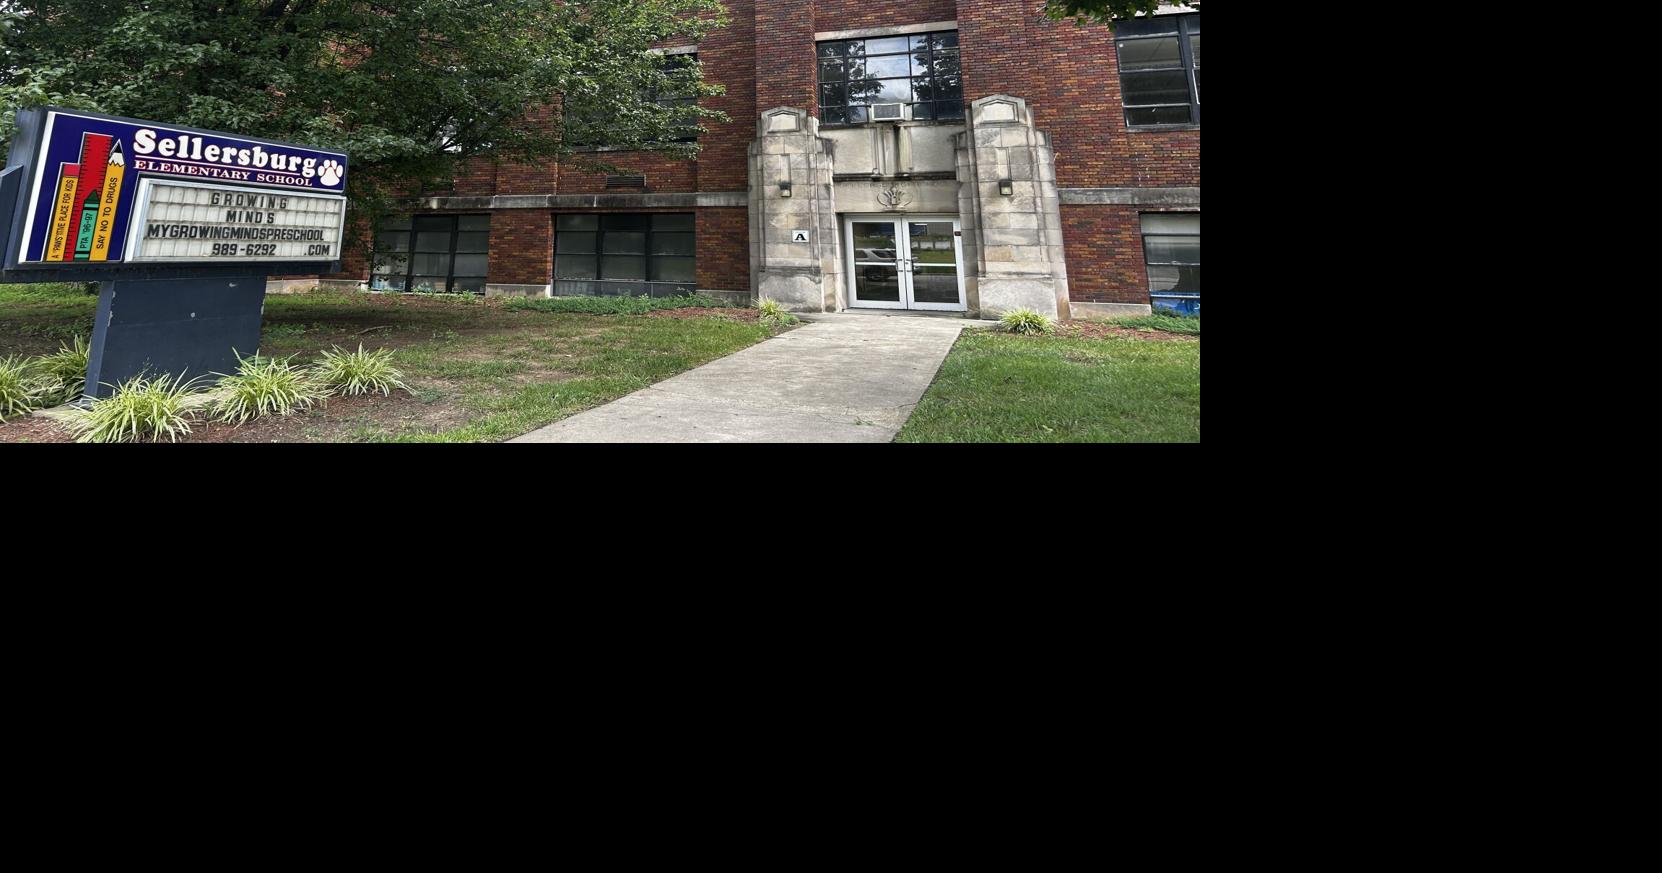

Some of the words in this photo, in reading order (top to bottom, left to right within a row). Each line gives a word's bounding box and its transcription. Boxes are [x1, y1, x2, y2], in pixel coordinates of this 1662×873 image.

[133, 128, 317, 177] Sellersburg
[133, 160, 250, 180] ELEMENTARY
[257, 174, 313, 186] SCHOOL
[65, 180, 73, 192] KIDS
[106, 177, 118, 204] DRUGS
[63, 193, 71, 203] FOR
[211, 193, 288, 209] GROWING
[59, 205, 69, 221] PLACE
[103, 206, 111, 217] TO
[226, 210, 275, 224] MINDS
[100, 220, 108, 232] NO
[147, 224, 324, 241] MYGROWINGMINDSPRESCHOOL
[80, 236, 89, 249] PTA
[96, 236, 104, 249] SAY
[794, 233, 806, 241] A
[304, 244, 330, 256] .COM
